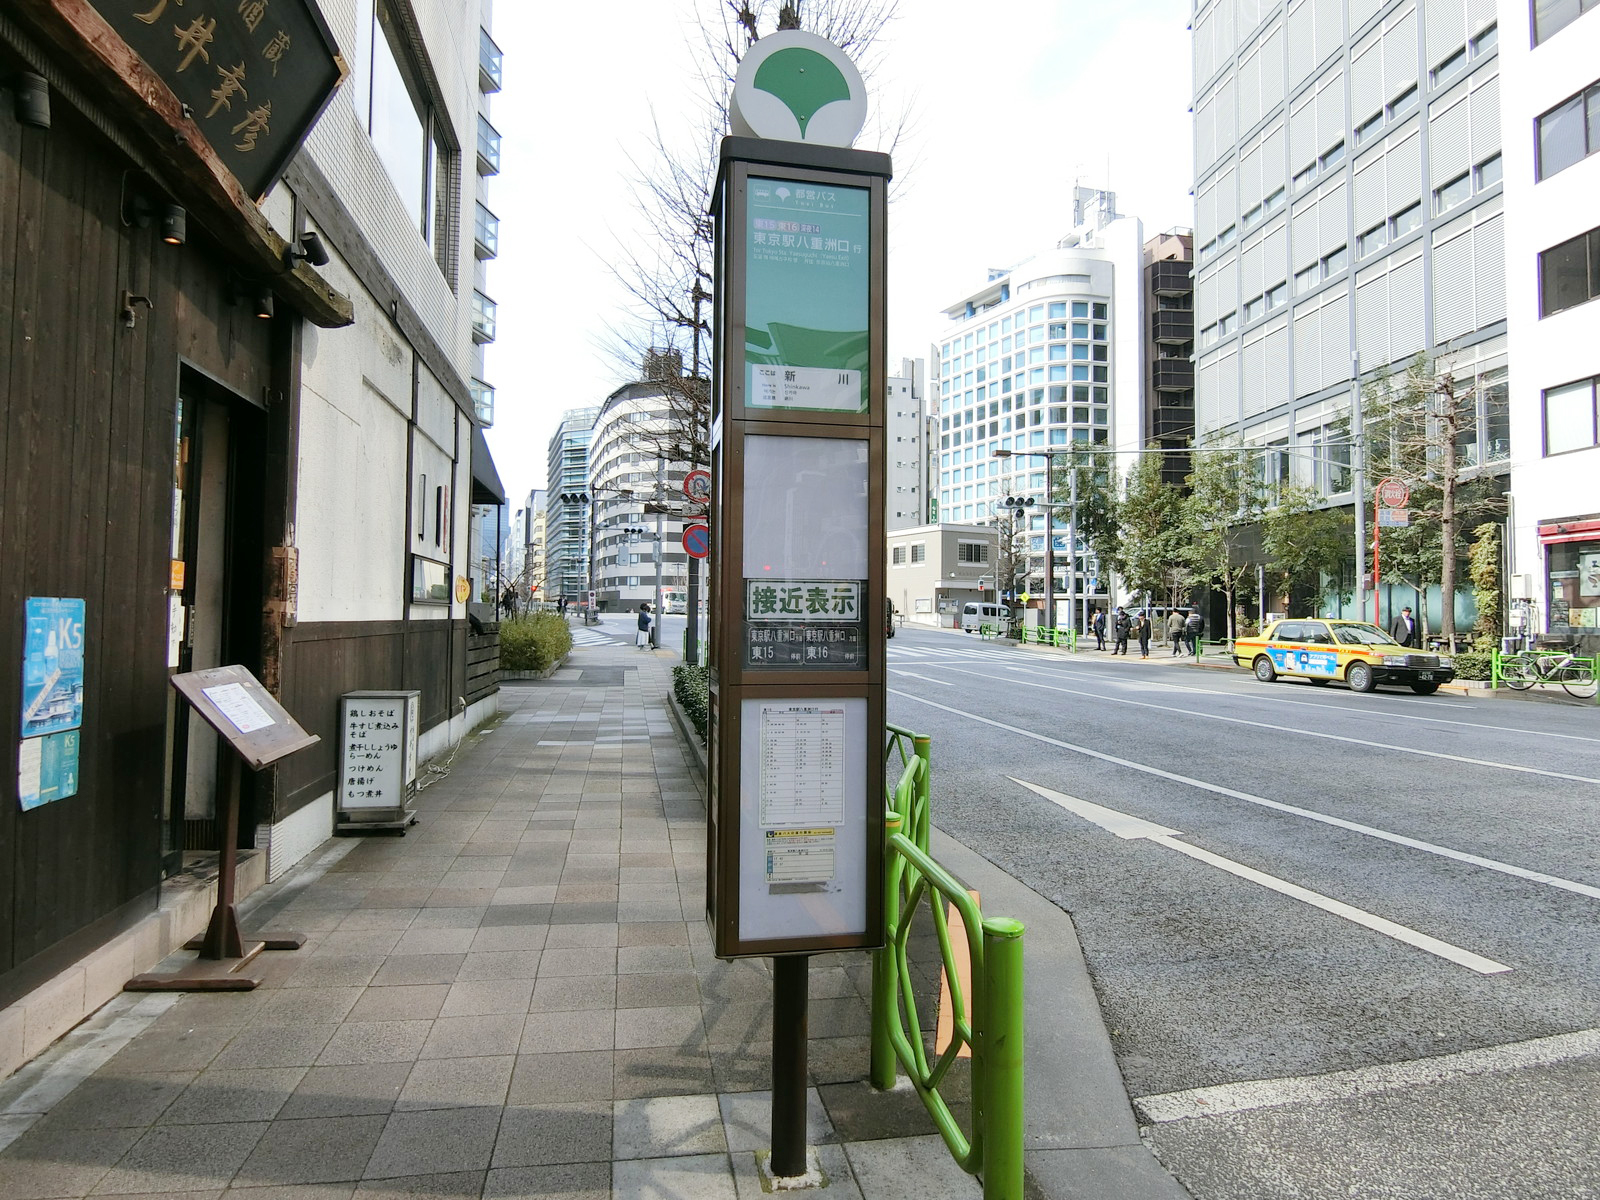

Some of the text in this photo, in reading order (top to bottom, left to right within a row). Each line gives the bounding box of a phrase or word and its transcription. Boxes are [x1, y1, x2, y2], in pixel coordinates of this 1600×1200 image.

[795, 189, 836, 202] 都営バス
[777, 221, 798, 231] 東16
[800, 224, 820, 233] 深夜14
[753, 232, 862, 254] 東京駅八重洲口 行
[784, 383, 811, 391] Shinkawa
[752, 586, 855, 615] 接近表示
[59, 617, 82, 650] K5
[751, 629, 795, 642] 東京駅八重洲口
[806, 629, 846, 642] 東京駅八重洲口
[751, 646, 774, 659] 東15
[806, 646, 828, 659] 東16
[349, 709, 395, 718] 鶏しおそば
[349, 722, 399, 731] 牛すじ煮込み
[350, 731, 367, 739] そば
[348, 743, 398, 752] 煮干ししょうゆ
[349, 752, 382, 760] らーめん
[348, 764, 384, 772] つけめん
[347, 777, 375, 786] 唐揚げ
[347, 790, 383, 799] もつ煮丼
